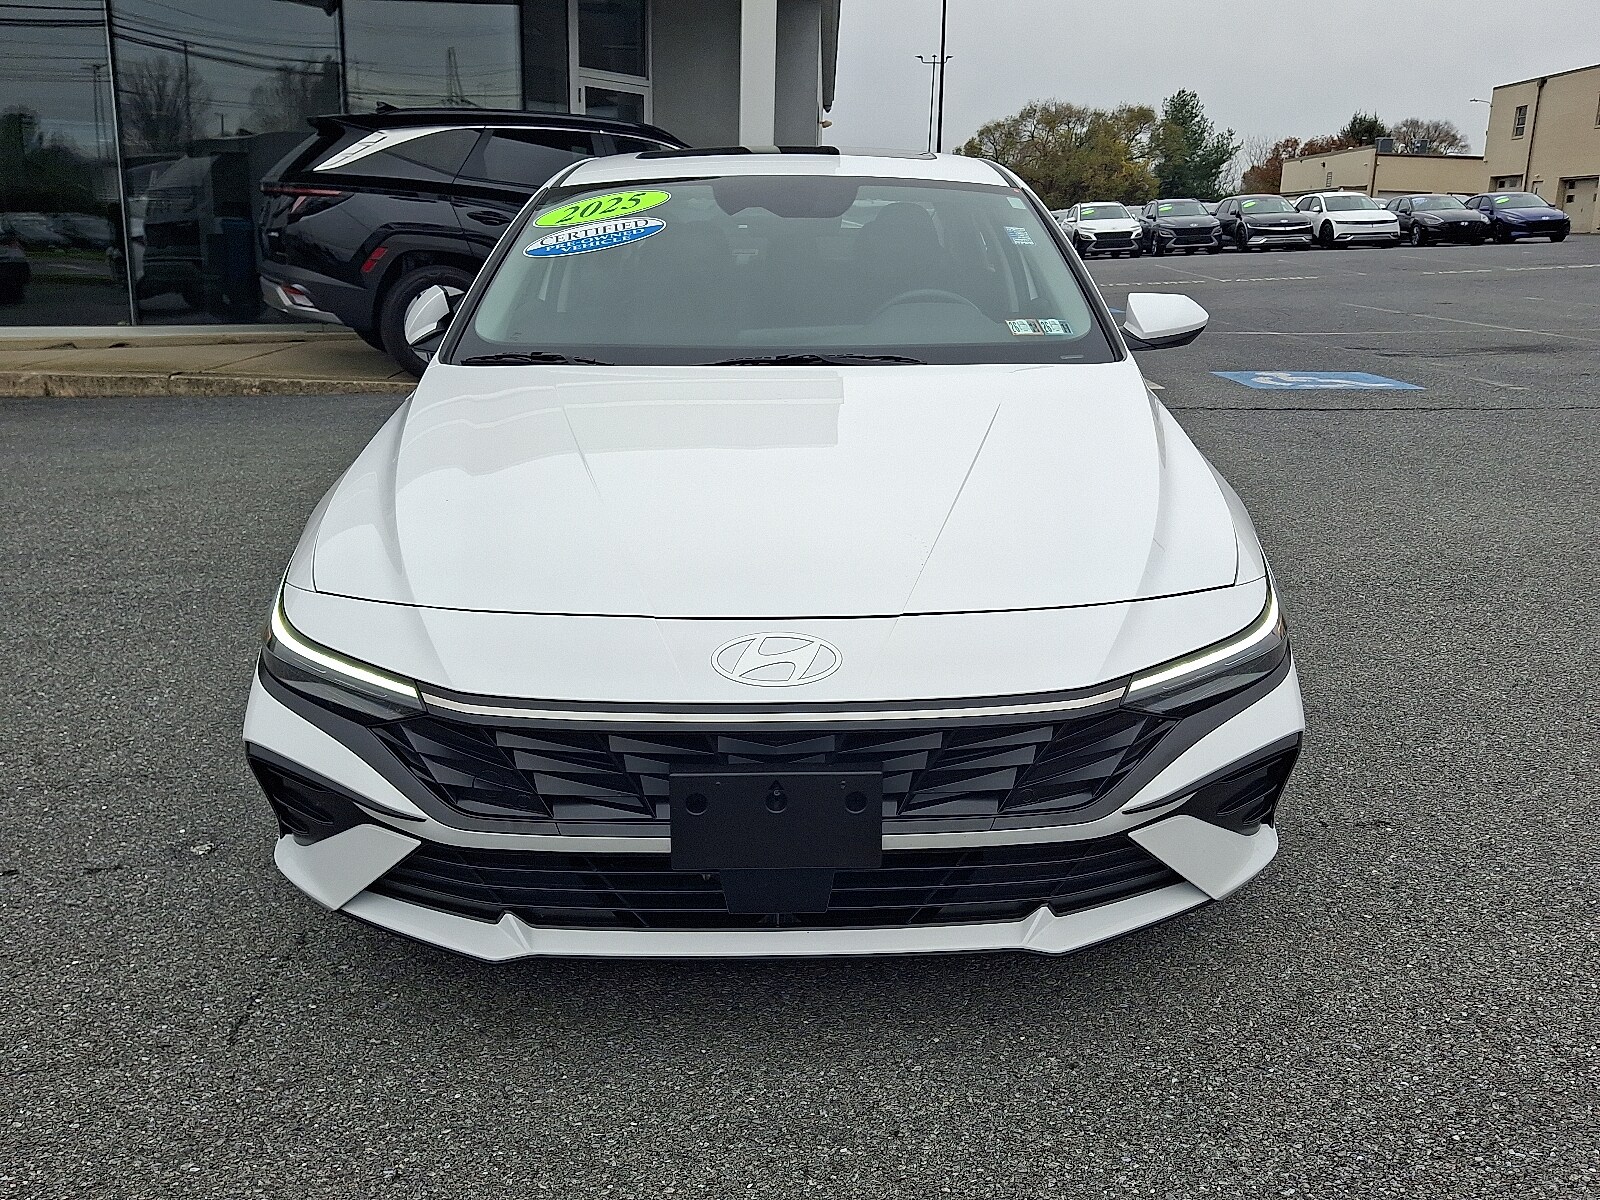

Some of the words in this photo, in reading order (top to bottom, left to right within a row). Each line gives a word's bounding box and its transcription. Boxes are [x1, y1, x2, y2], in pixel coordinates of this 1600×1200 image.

[555, 192, 646, 224] 2025
[540, 218, 649, 246] CERTIFIED
[545, 228, 645, 252] PRE-OWNED
[561, 234, 632, 252] VEHICLE
[1041, 321, 1052, 332] 26
